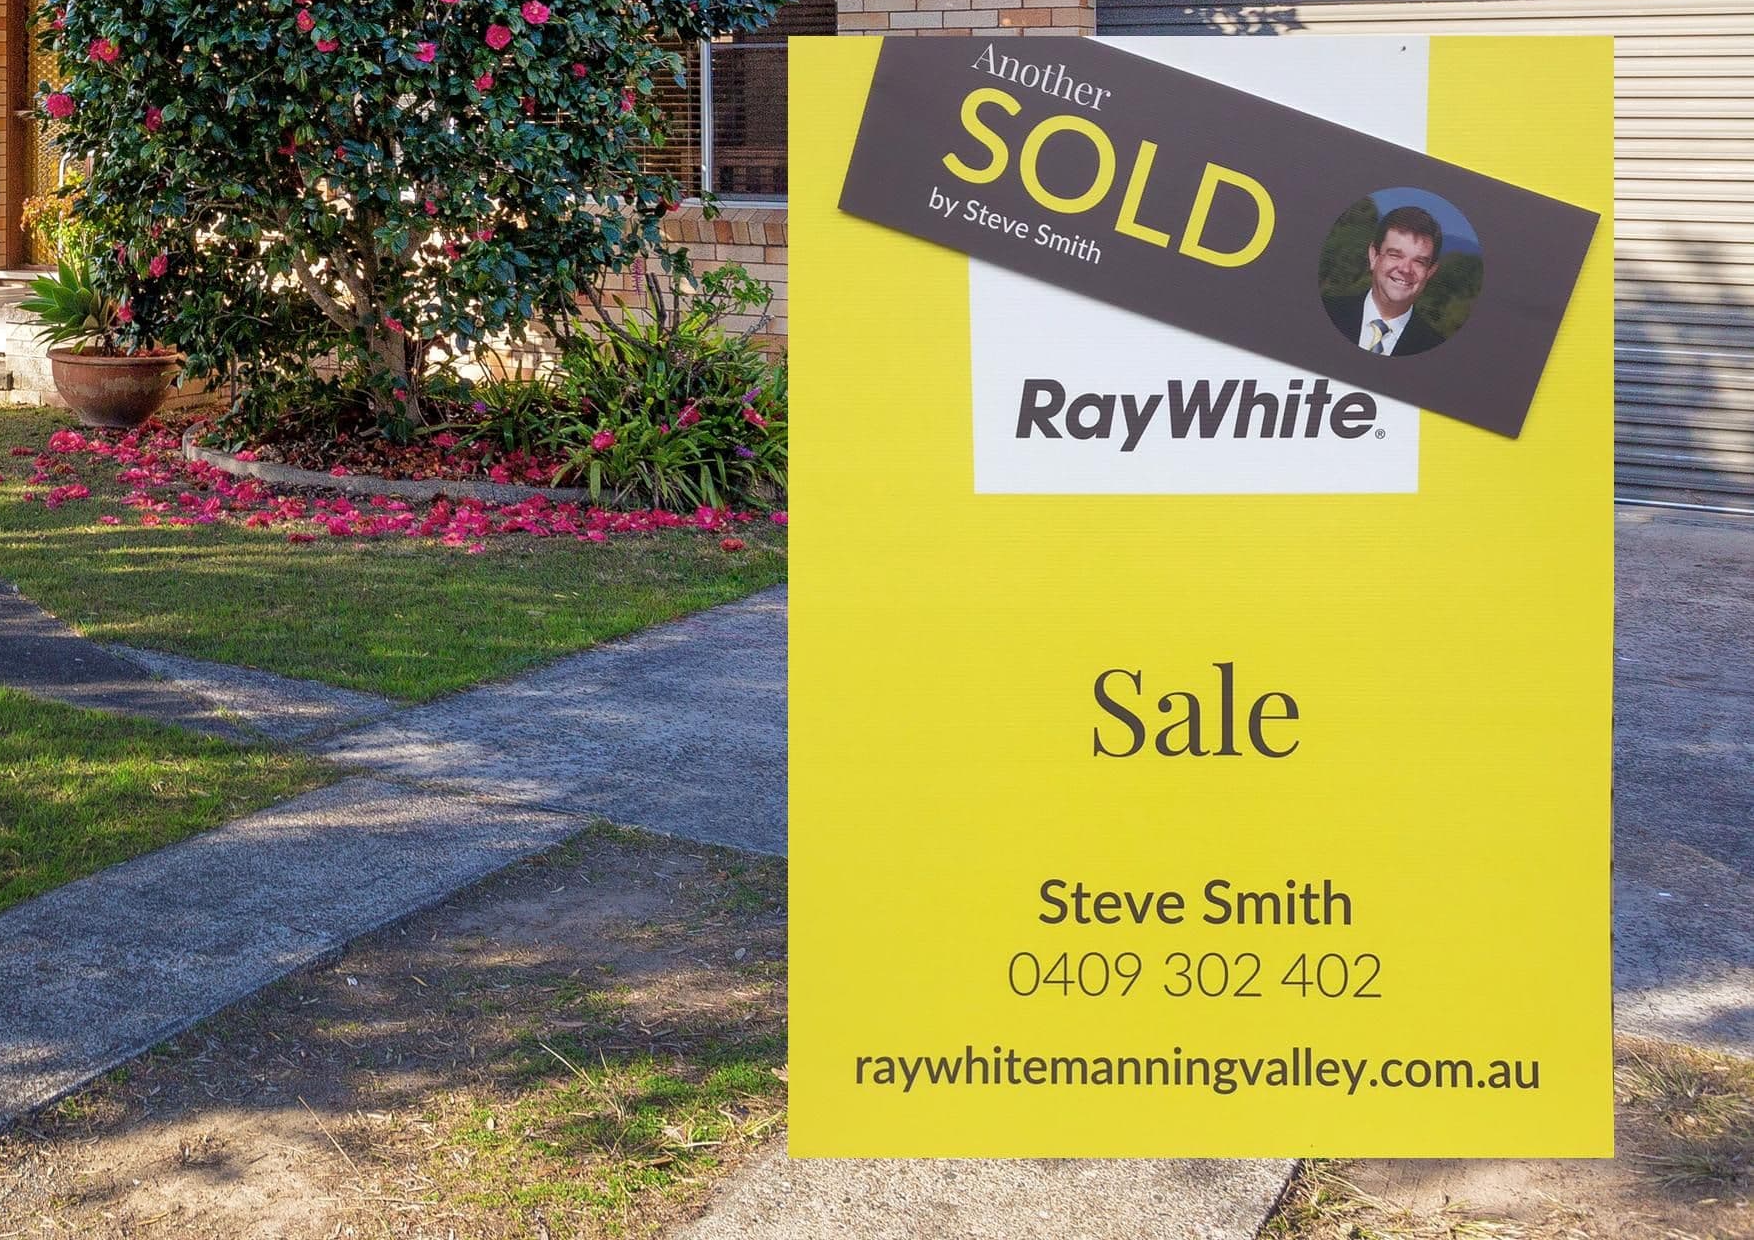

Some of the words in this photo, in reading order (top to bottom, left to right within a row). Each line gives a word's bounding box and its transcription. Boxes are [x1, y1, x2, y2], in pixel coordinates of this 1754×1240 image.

[971, 42, 1112, 111] Another
[942, 87, 1276, 267] SOLD
[928, 186, 960, 218] by
[962, 200, 1029, 239] Steve
[1034, 224, 1102, 265] Smith
[1092, 661, 1301, 759] Sale
[1038, 878, 1185, 925] Steve
[1202, 879, 1352, 926] Smith
[1008, 951, 1142, 997] 0409
[1163, 951, 1263, 998] 302
[1280, 952, 1383, 999] 402
[855, 1045, 1540, 1096] raywhitemanningvalley.com.au
